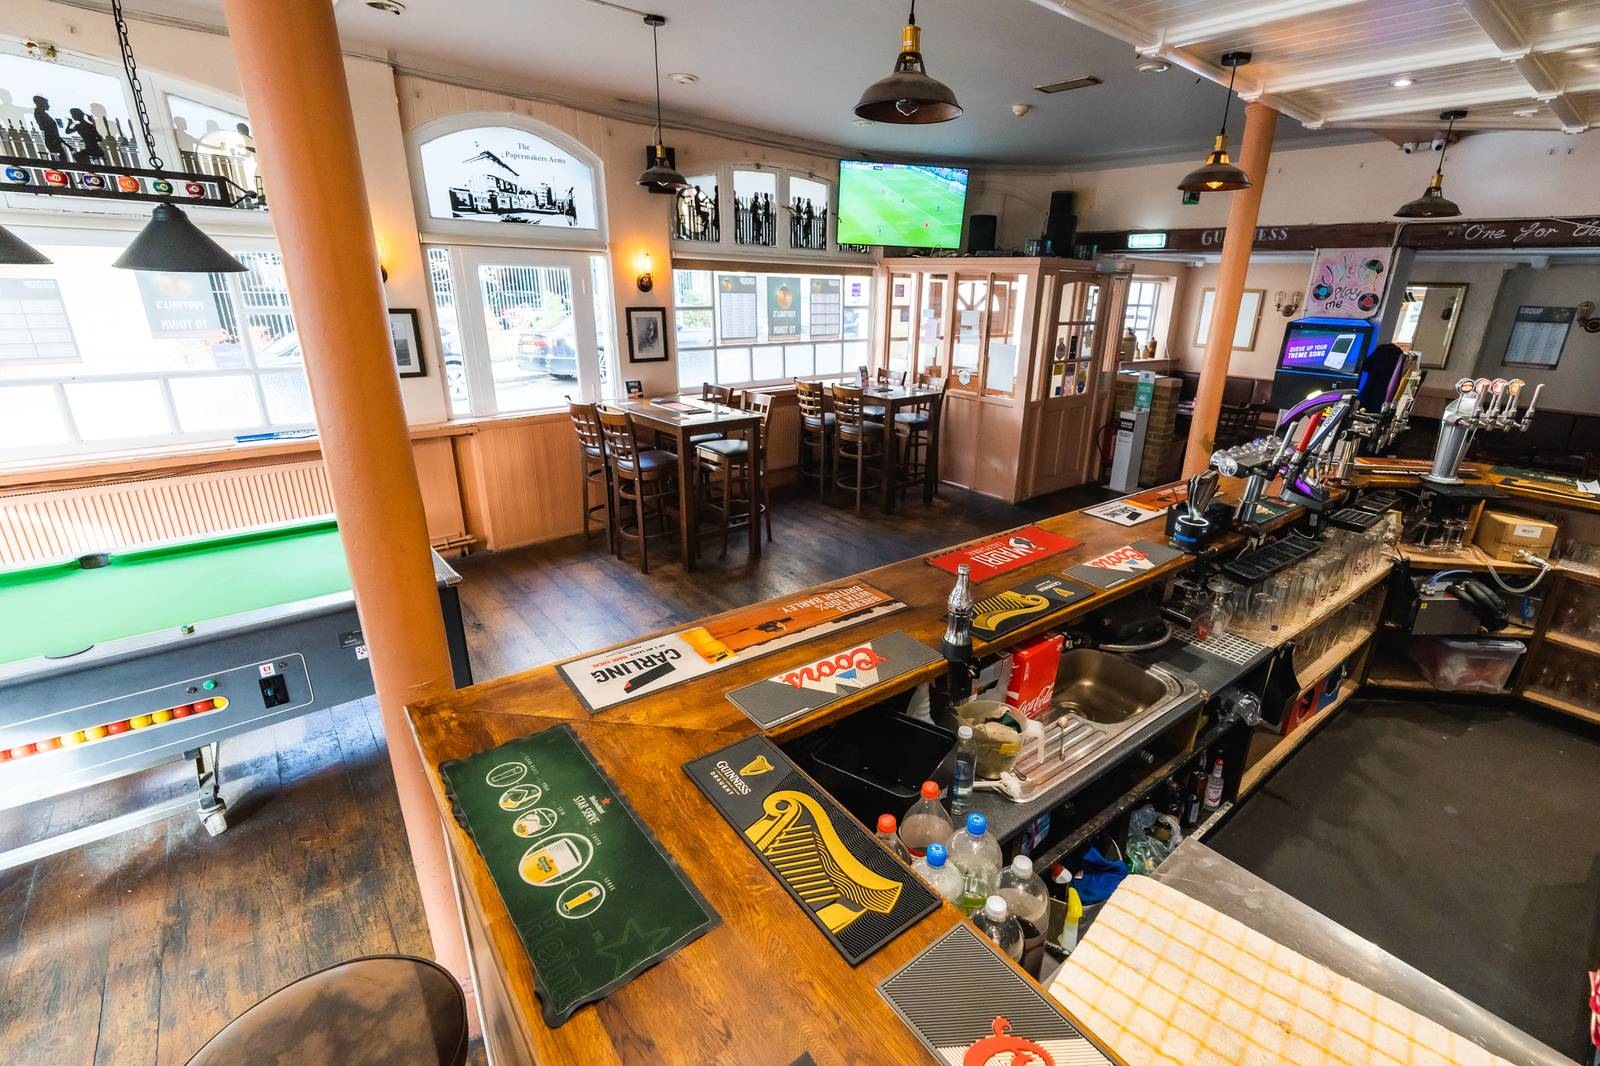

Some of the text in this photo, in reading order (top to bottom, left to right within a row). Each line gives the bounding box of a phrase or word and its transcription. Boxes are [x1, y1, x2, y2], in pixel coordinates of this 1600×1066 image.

[505, 151, 547, 161] Papermakers
[1201, 227, 1289, 245] GUESS
[1513, 222, 1558, 242] for
[1325, 300, 1343, 309] me
[815, 590, 875, 611] WITH 100%
[822, 585, 864, 600] BRITISH
[837, 595, 883, 612] BREWED
[590, 648, 682, 682] CARLING
[782, 647, 888, 689] Coors
[710, 771, 734, 795] DRAUGHT
[716, 760, 752, 795] GUINNESS
[572, 795, 600, 826] STAR SERVE
